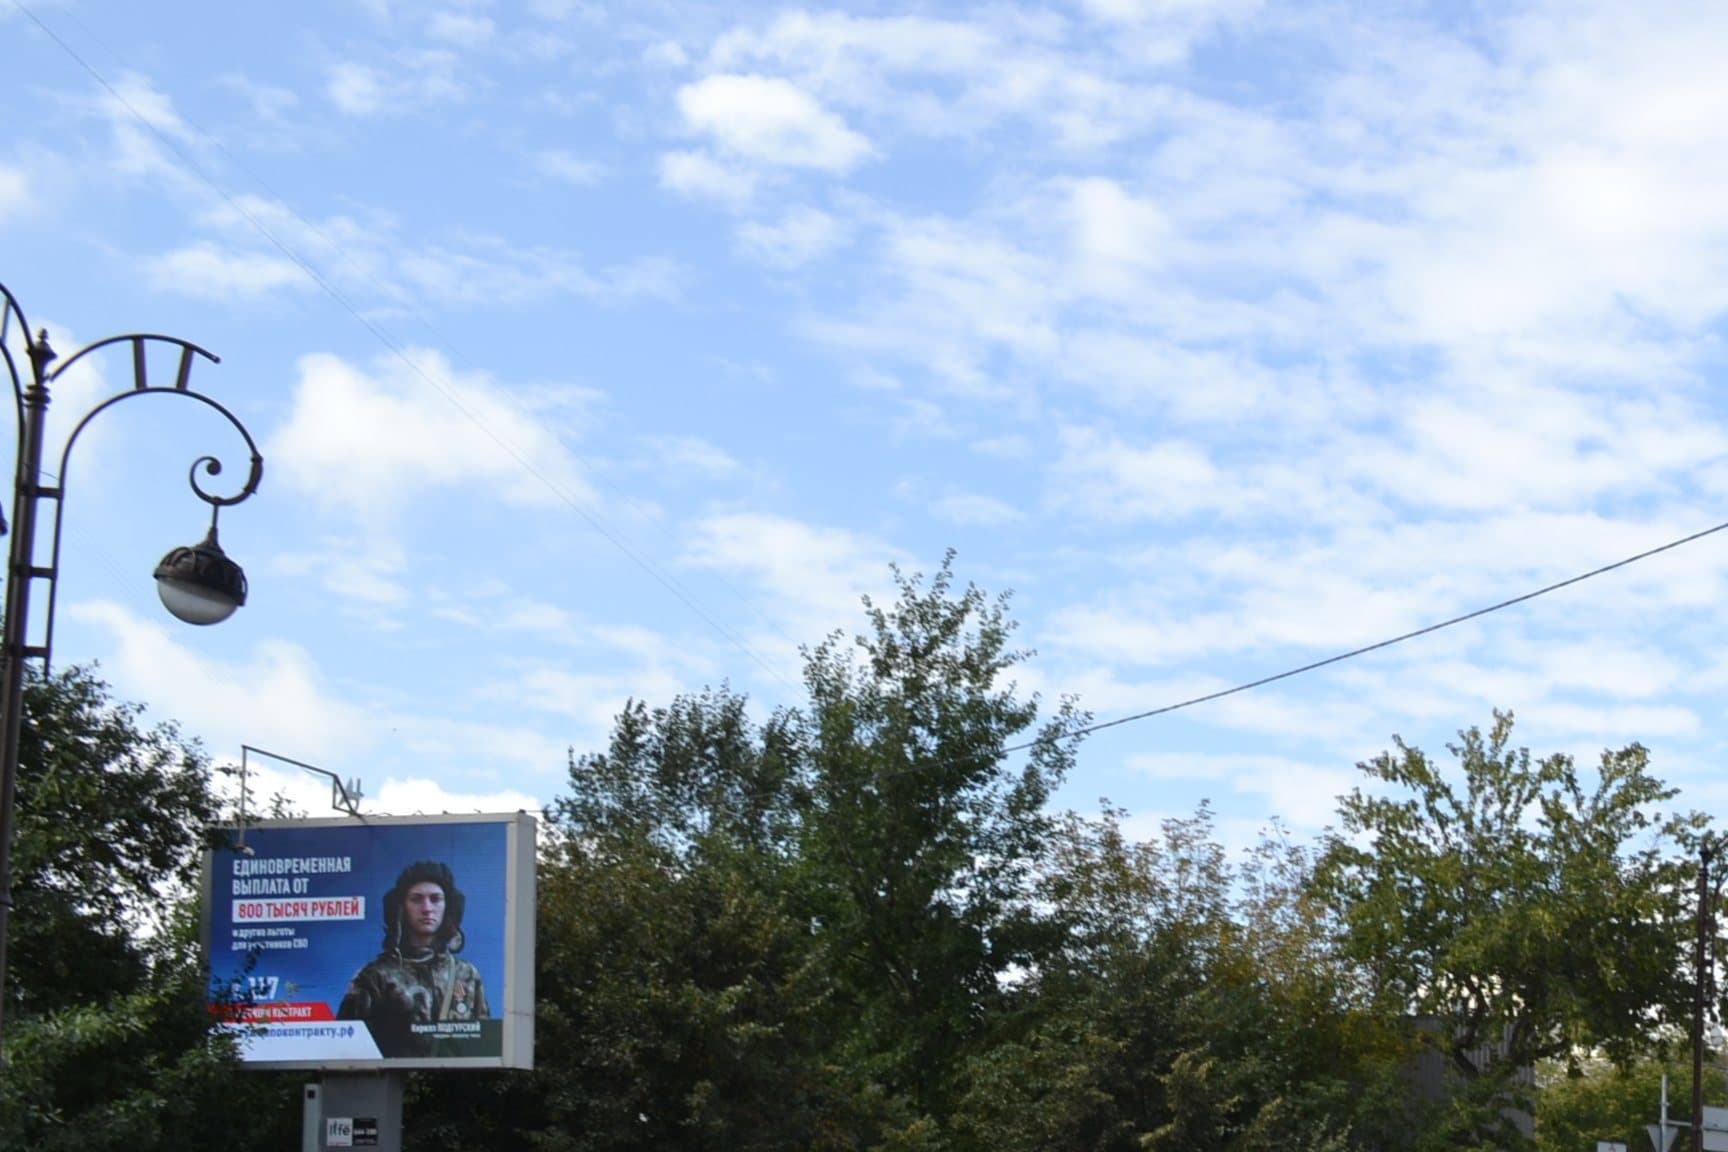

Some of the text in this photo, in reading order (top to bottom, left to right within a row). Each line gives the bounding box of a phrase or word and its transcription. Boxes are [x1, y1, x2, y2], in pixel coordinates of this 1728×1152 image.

[233, 857, 351, 876] ЕДИНОВРЕМЕННАЯ
[232, 879, 309, 895] ВЫПЛАТА ОТ
[265, 902, 307, 917] ТЫСЯЧ
[312, 897, 359, 916] РУБЛЕЙ
